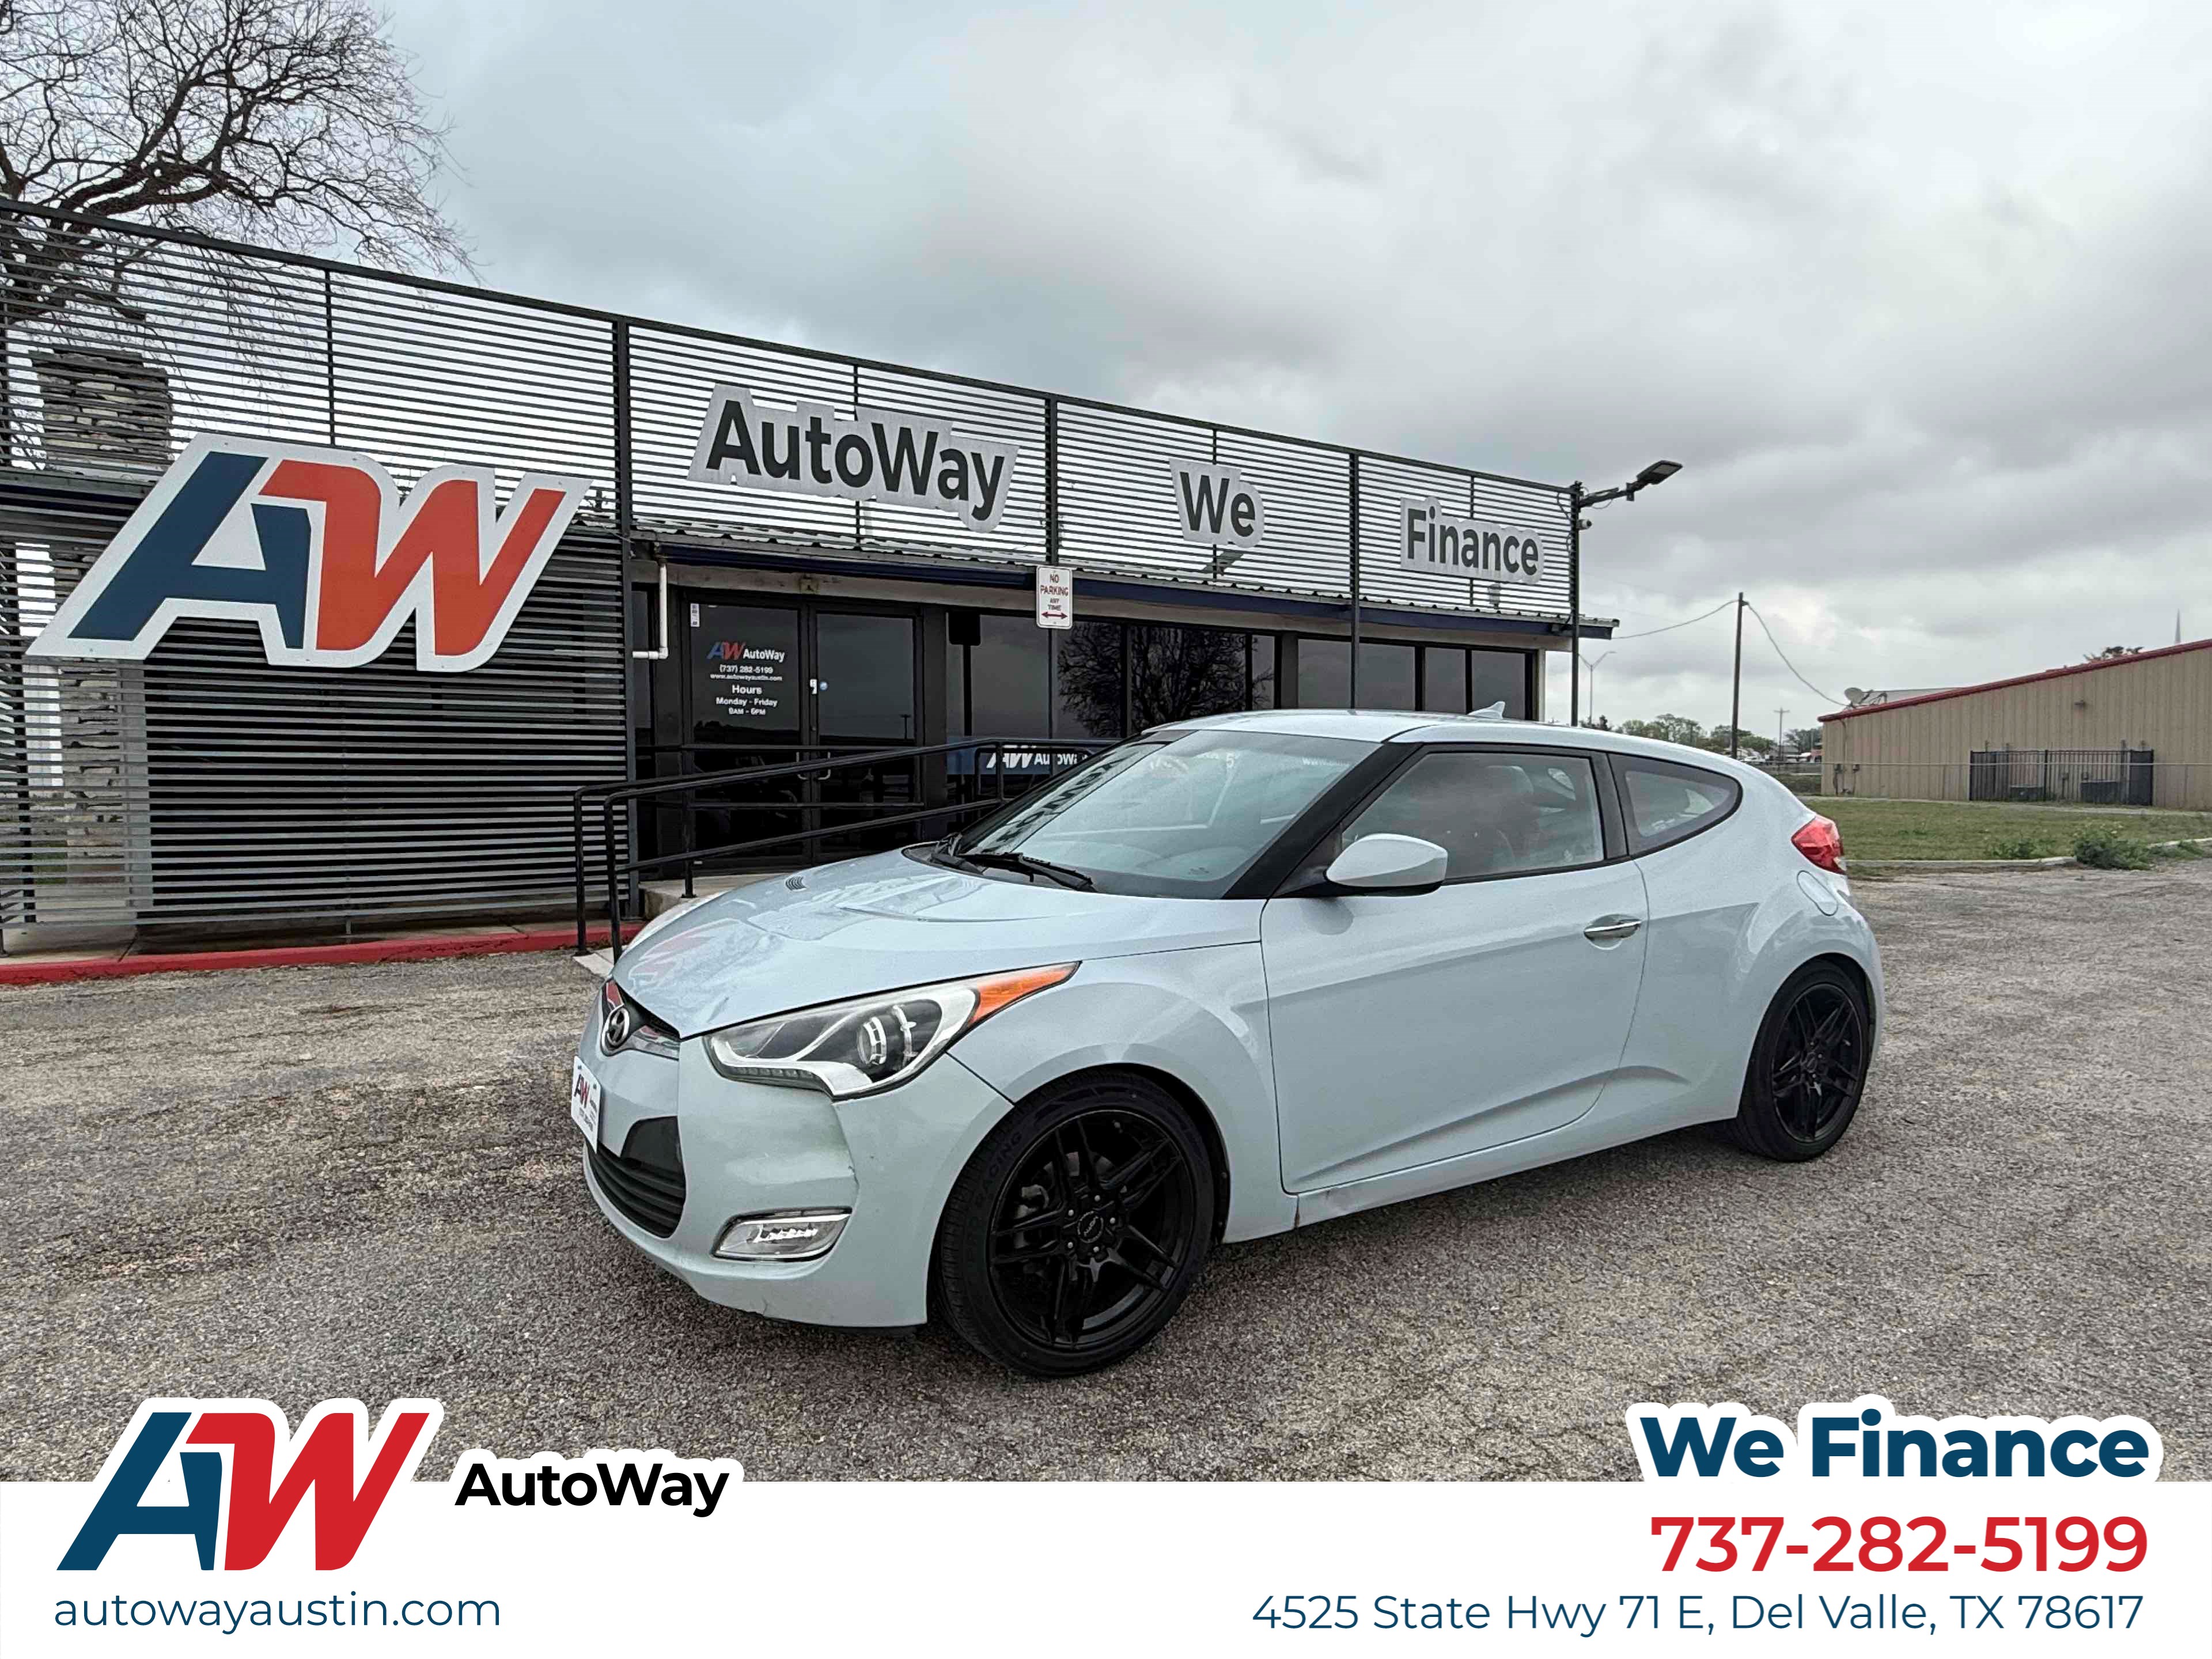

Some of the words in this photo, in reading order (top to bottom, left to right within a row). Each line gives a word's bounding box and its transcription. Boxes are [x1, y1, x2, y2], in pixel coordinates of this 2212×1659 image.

[706, 400, 1005, 521] AutoWay
[1179, 471, 1256, 537] We
[1407, 506, 1540, 576] Finance
[66, 451, 567, 656] AW
[1050, 574, 1059, 584] NO
[1040, 585, 1069, 596] PARKING
[707, 641, 746, 660] AW
[743, 649, 785, 662] AutoWay
[719, 664, 738, 673] (737)
[732, 684, 762, 695] Hours
[716, 697, 748, 707] Monday
[754, 698, 778, 707] Friday
